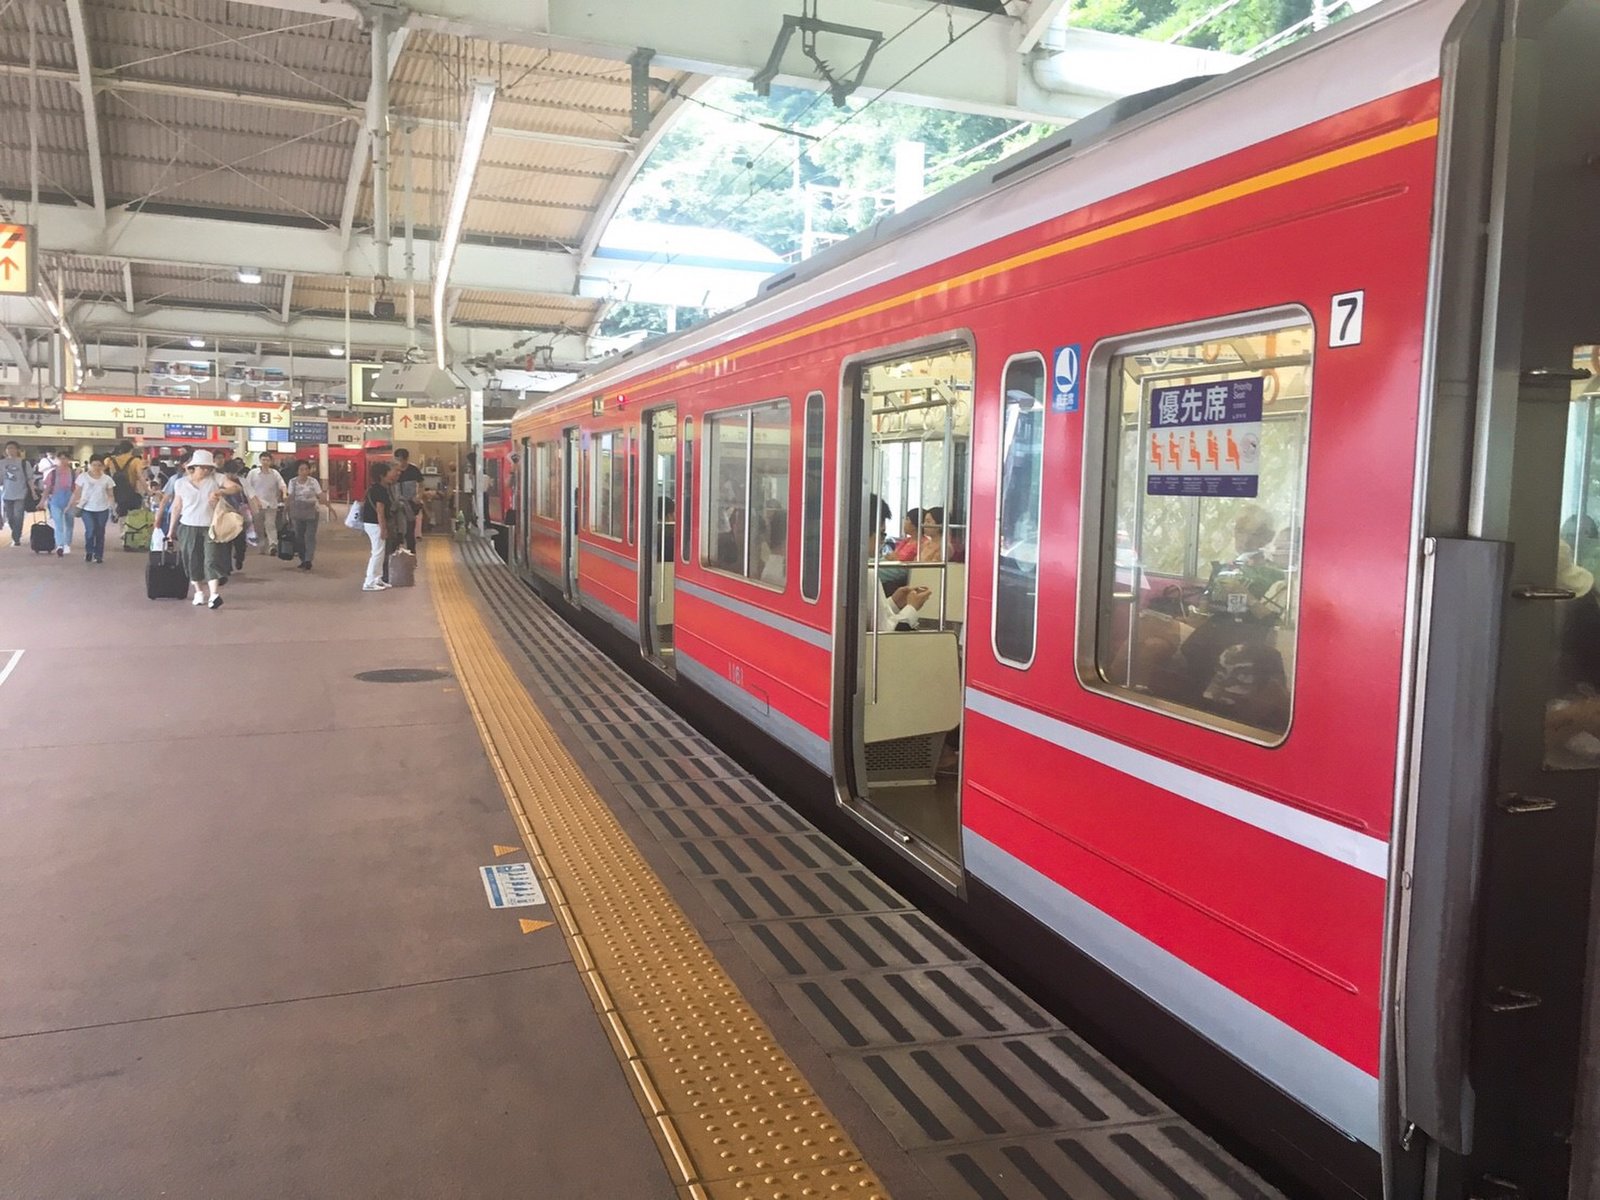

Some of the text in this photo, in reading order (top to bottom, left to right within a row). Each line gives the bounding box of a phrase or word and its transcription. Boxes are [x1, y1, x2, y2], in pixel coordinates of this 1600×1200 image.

[1338, 297, 1358, 341] 7
[124, 408, 146, 418] 出口
[261, 413, 268, 422] 3
[1158, 385, 1229, 425] 優先席
